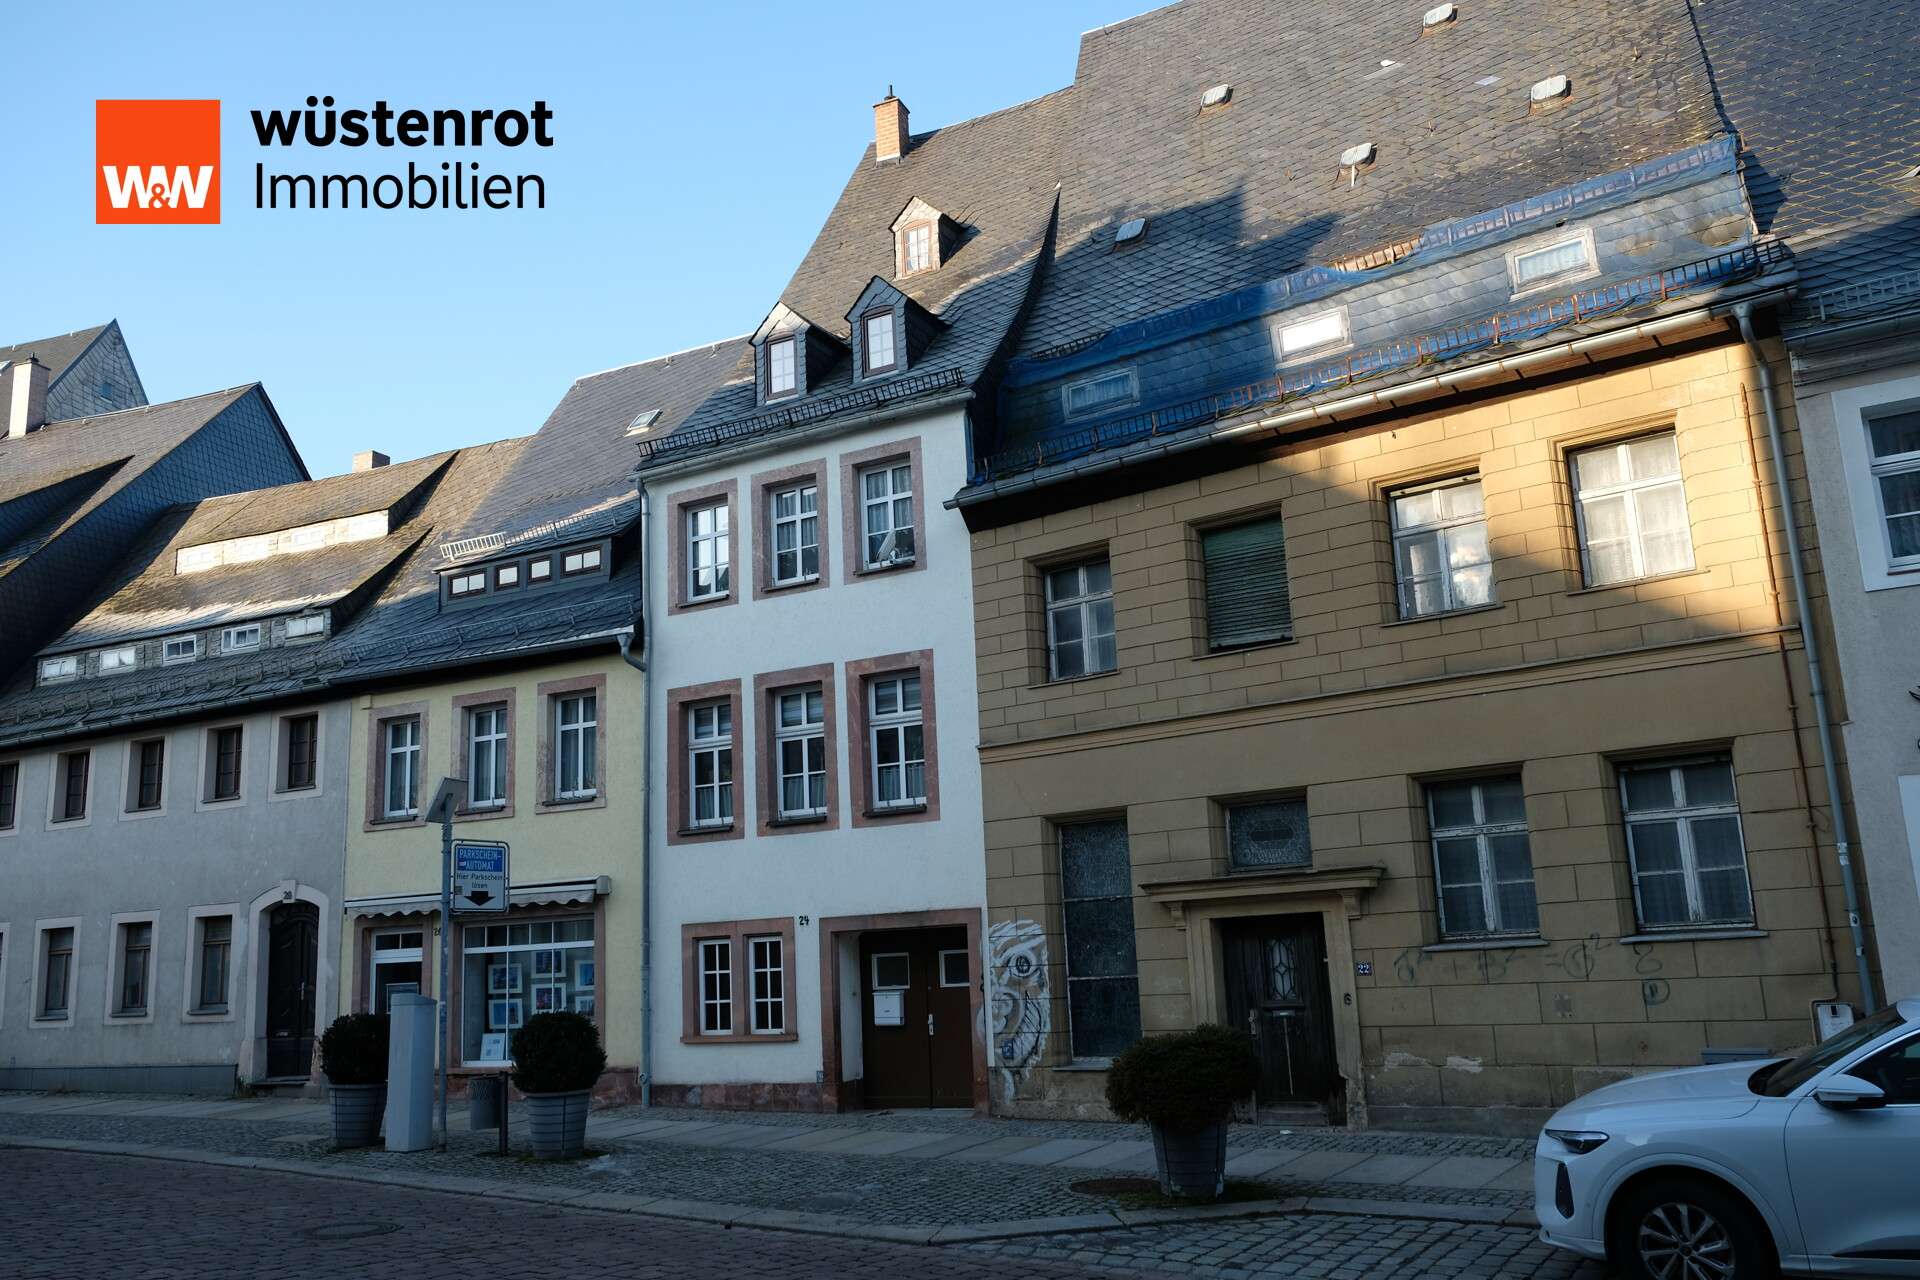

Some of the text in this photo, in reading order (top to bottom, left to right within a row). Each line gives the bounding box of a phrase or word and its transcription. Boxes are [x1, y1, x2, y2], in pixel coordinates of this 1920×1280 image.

[465, 860, 494, 870] AUTOMAT
[456, 872, 503, 881] Hier Parkschein
[471, 881, 488, 889] lösen
[798, 915, 810, 926] 24
[1356, 964, 1370, 974] 22
